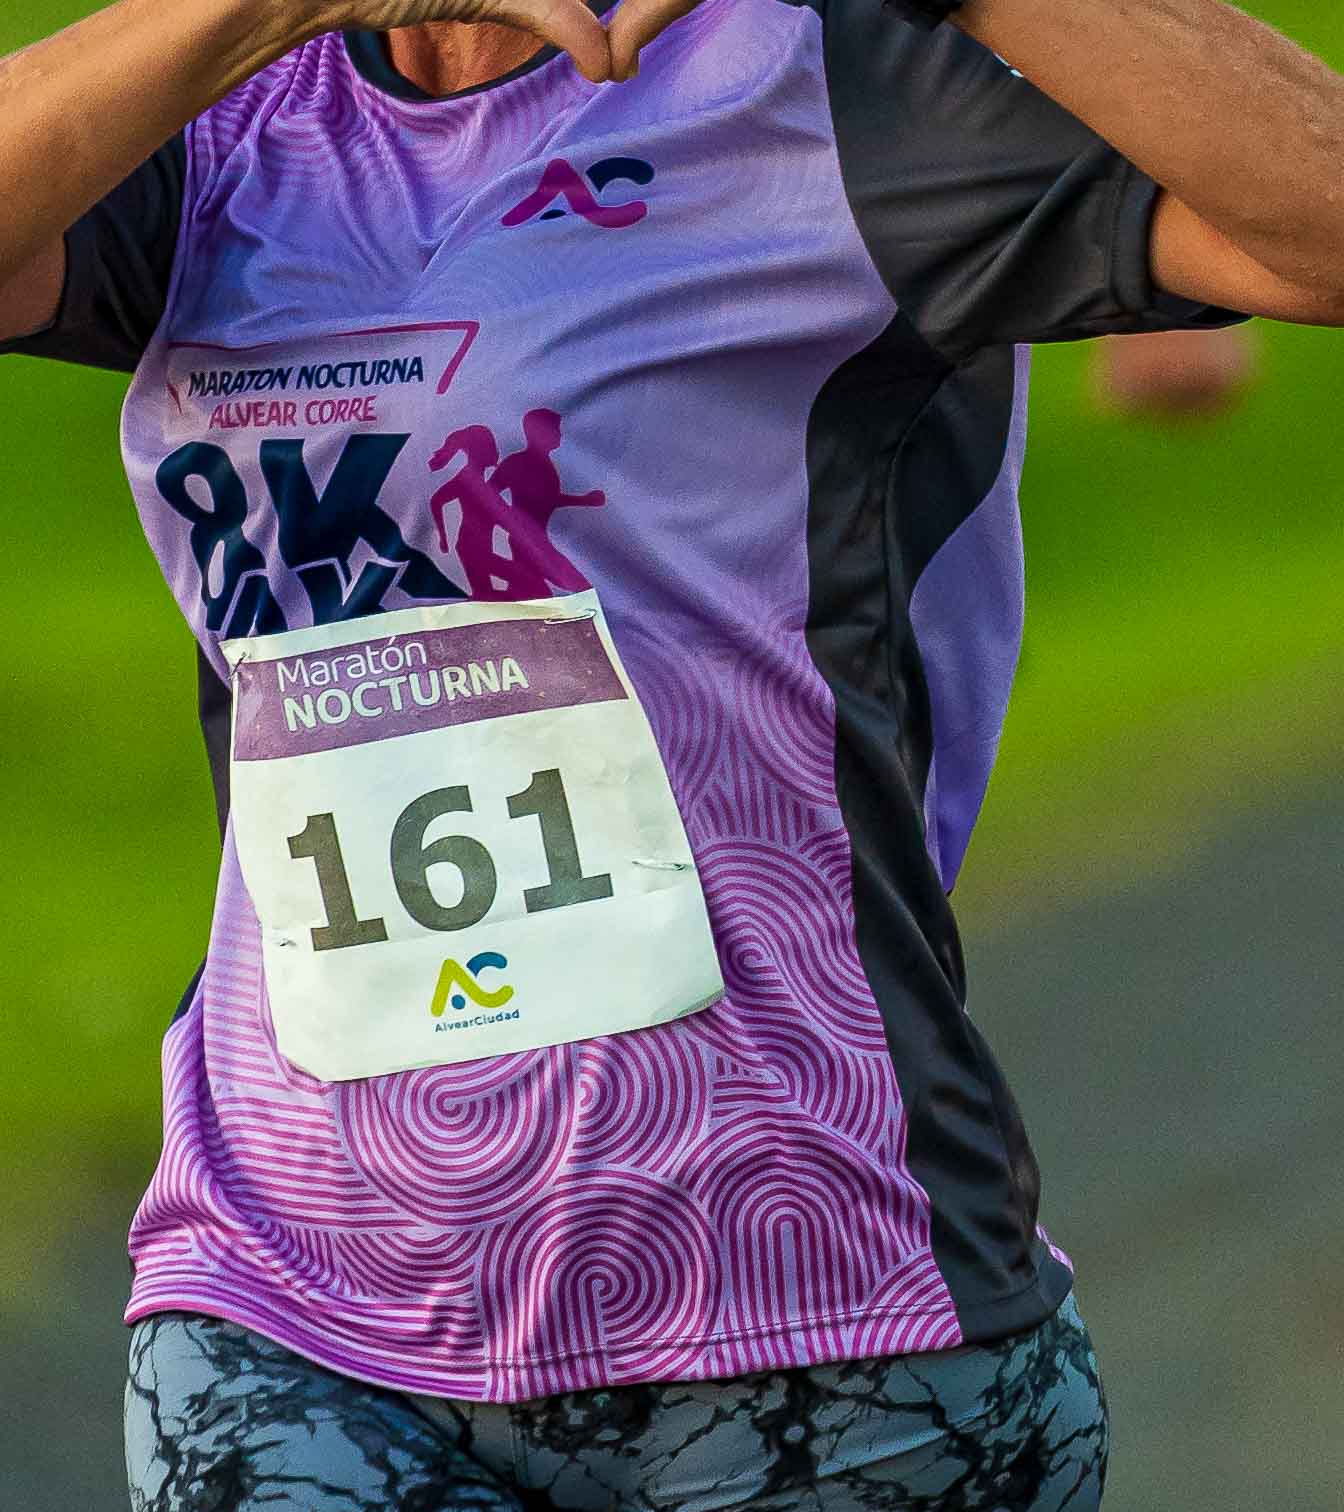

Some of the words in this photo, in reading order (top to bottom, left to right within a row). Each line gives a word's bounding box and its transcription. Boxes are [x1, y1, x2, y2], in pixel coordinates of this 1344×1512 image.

[296, 356, 425, 390] NOCTURNA
[209, 400, 297, 428] ALVEAR
[305, 395, 378, 423] CORRE
[277, 636, 427, 692] Maratón
[284, 657, 529, 732] NOCTURNA
[287, 768, 615, 952] 161
[435, 1009, 520, 1032] AlvearCiudad
